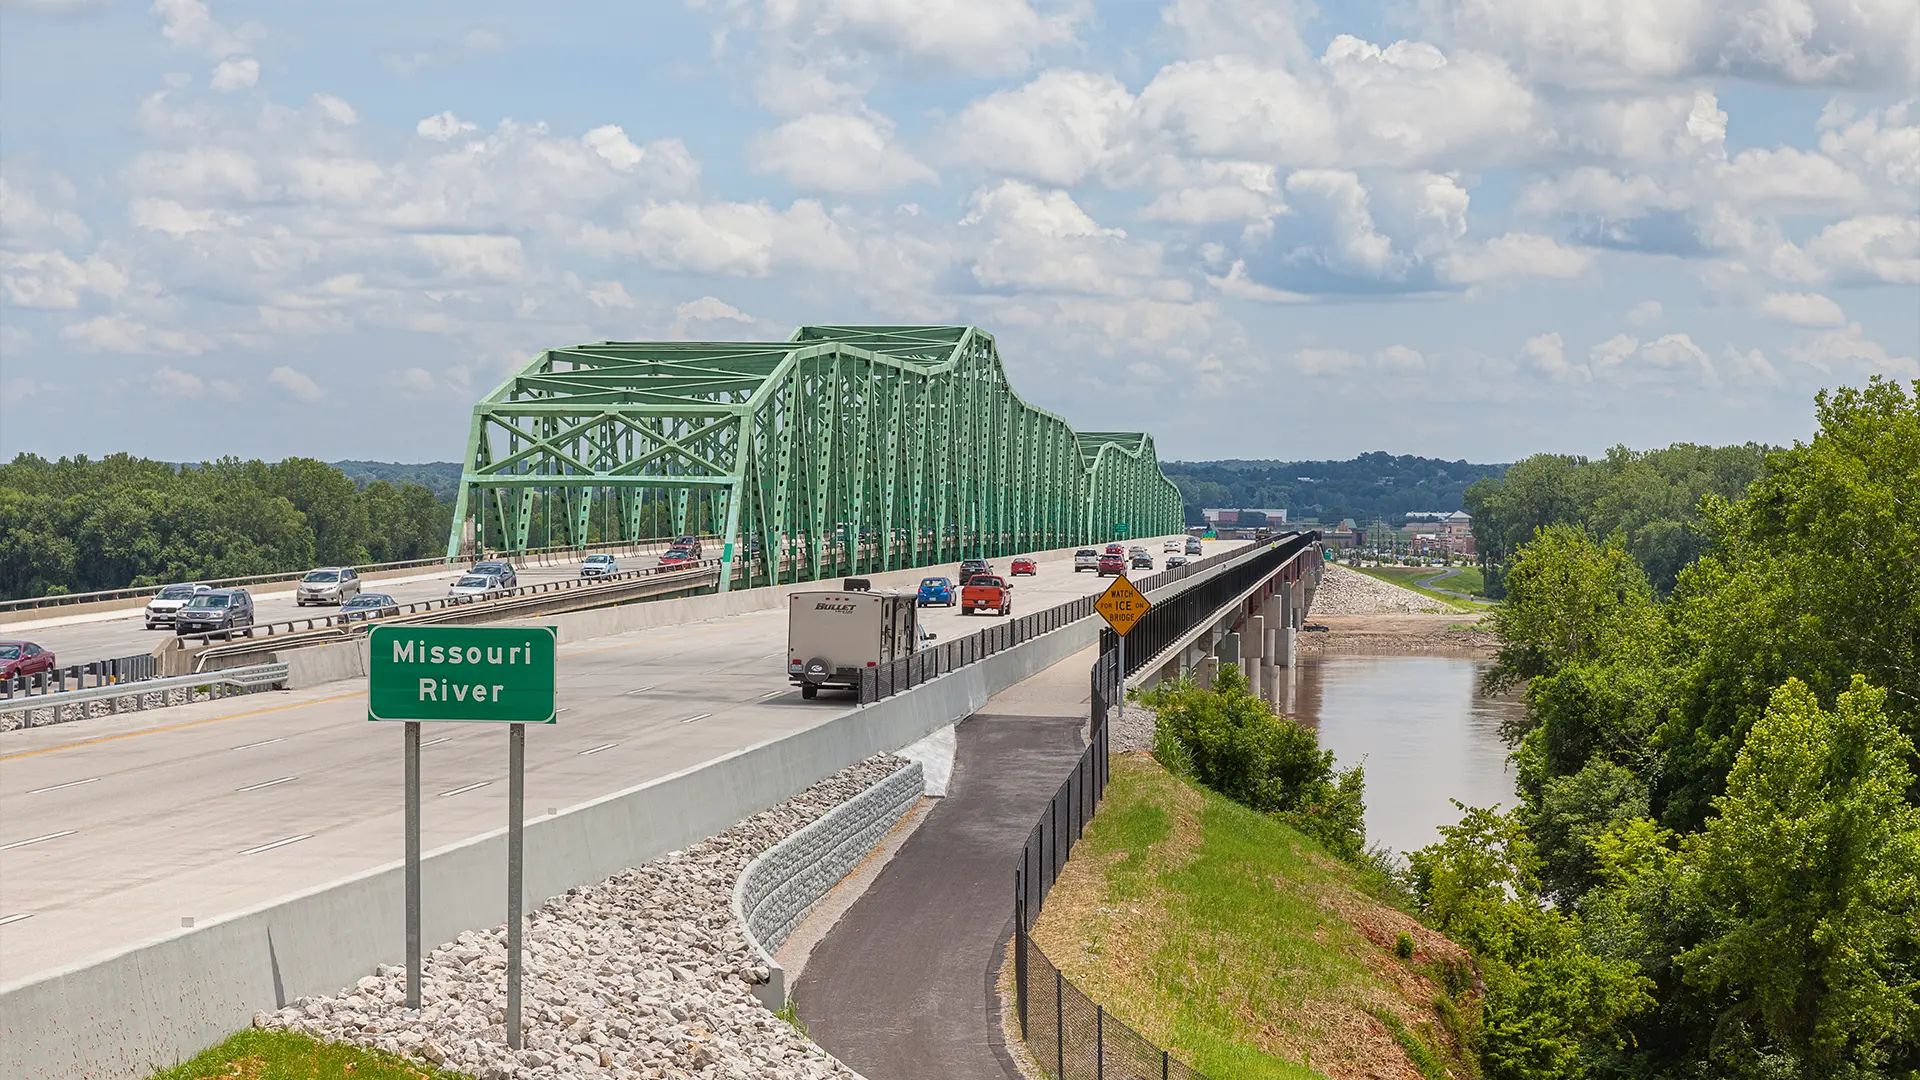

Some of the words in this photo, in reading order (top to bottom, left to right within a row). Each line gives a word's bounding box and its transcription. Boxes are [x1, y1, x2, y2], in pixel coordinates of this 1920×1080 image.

[1111, 590, 1134, 598] WATCH
[814, 602, 857, 611] BULLET
[1115, 601, 1132, 610] ICE
[1109, 613, 1135, 621] BRIDGE
[393, 640, 531, 664] Missouri
[419, 678, 504, 702] River
